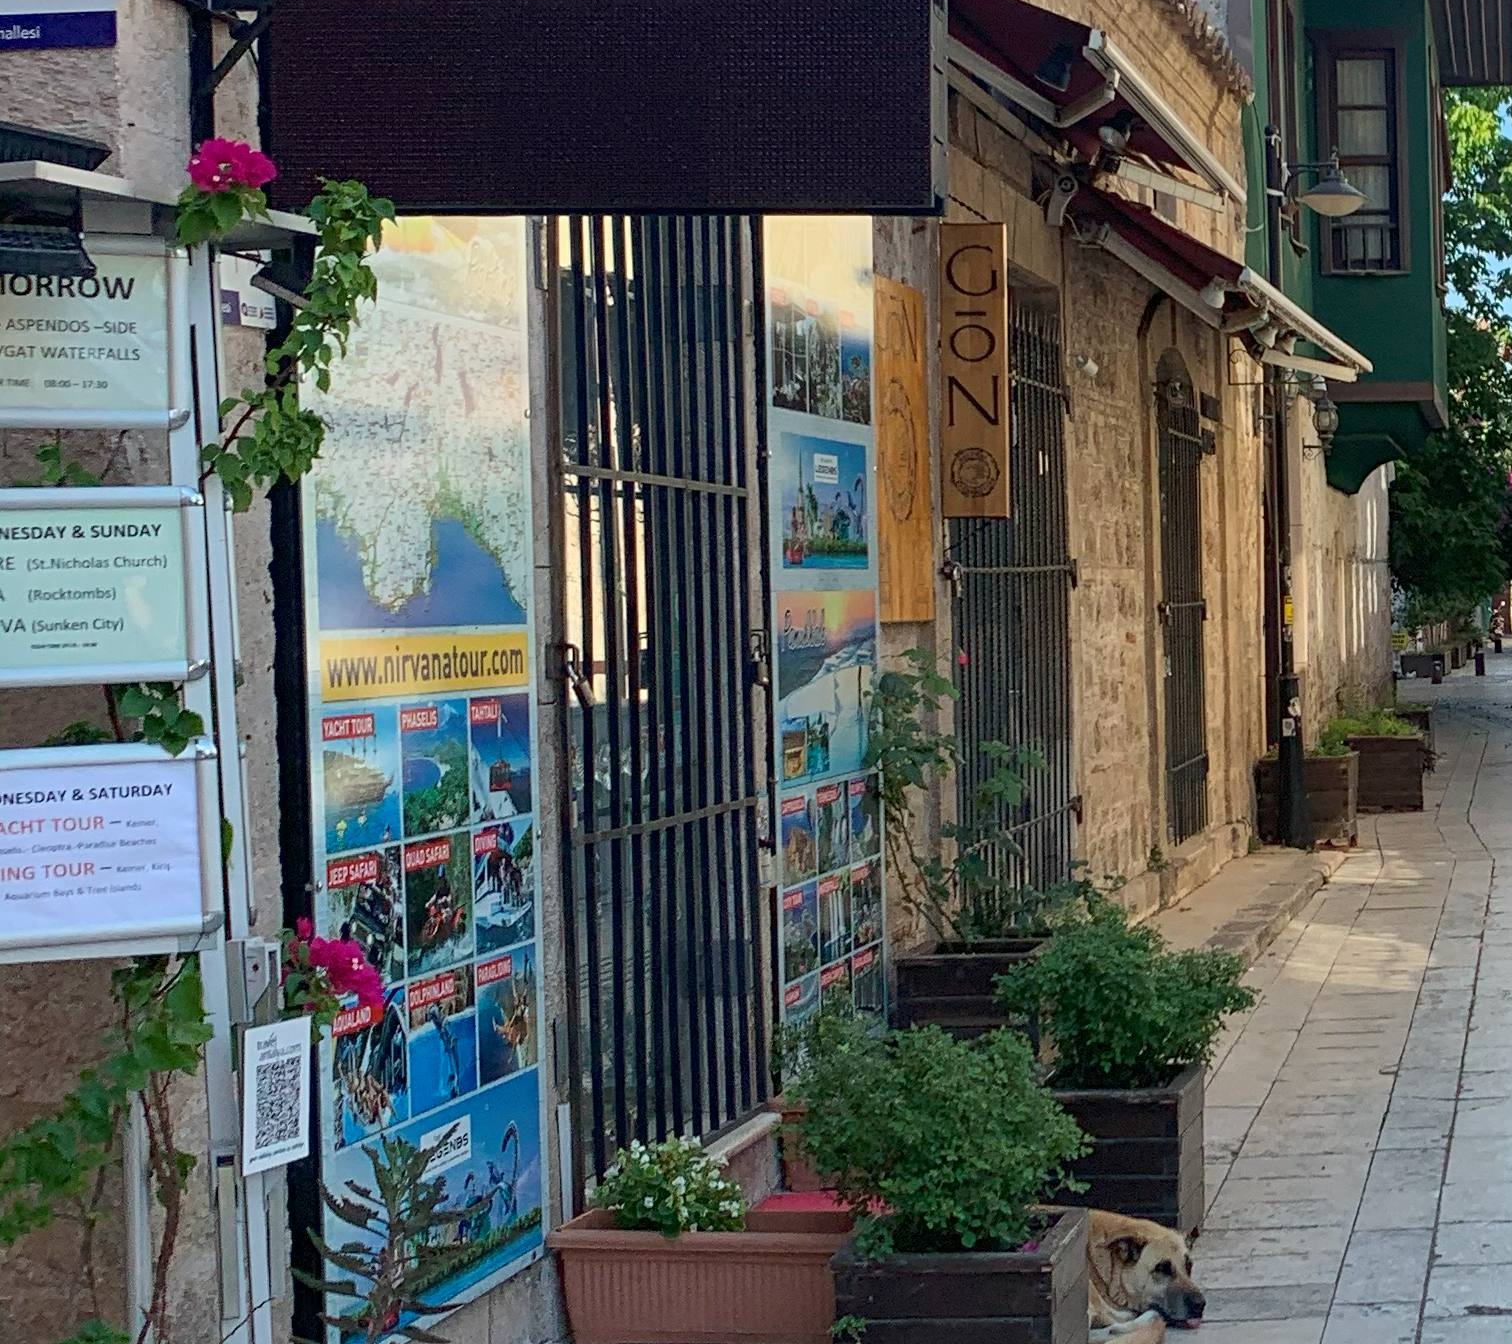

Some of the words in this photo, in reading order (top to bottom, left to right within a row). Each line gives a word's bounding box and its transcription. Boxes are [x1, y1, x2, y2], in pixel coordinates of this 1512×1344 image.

[0, 274, 135, 300] ORROW
[5, 318, 91, 333] ASPENDOS
[40, 346, 141, 361] WATERFALLS
[72, 525, 85, 538] &
[91, 524, 162, 538] SUNDAY
[114, 555, 168, 568] Church)
[28, 588, 116, 603] (Rocktombs)
[31, 620, 88, 634] (Sunken
[93, 617, 124, 632] City)
[327, 645, 524, 688] www.nirvanatour.com
[323, 718, 349, 737] YACHT
[350, 715, 373, 735] TOUR
[401, 709, 438, 727] PHASELIS
[0, 790, 67, 806] NESDAY
[72, 789, 83, 801] &
[89, 784, 173, 800] SATURDAY
[52, 816, 105, 832] TOUR
[404, 849, 425, 869] QUAD
[425, 842, 450, 864] SAFARI
[42, 862, 95, 879] TOUR
[328, 865, 349, 886] JEEP
[350, 859, 378, 881] SAFARI
[409, 977, 455, 1007] DOLPHINLAND
[333, 1006, 372, 1034] AQUALAND
